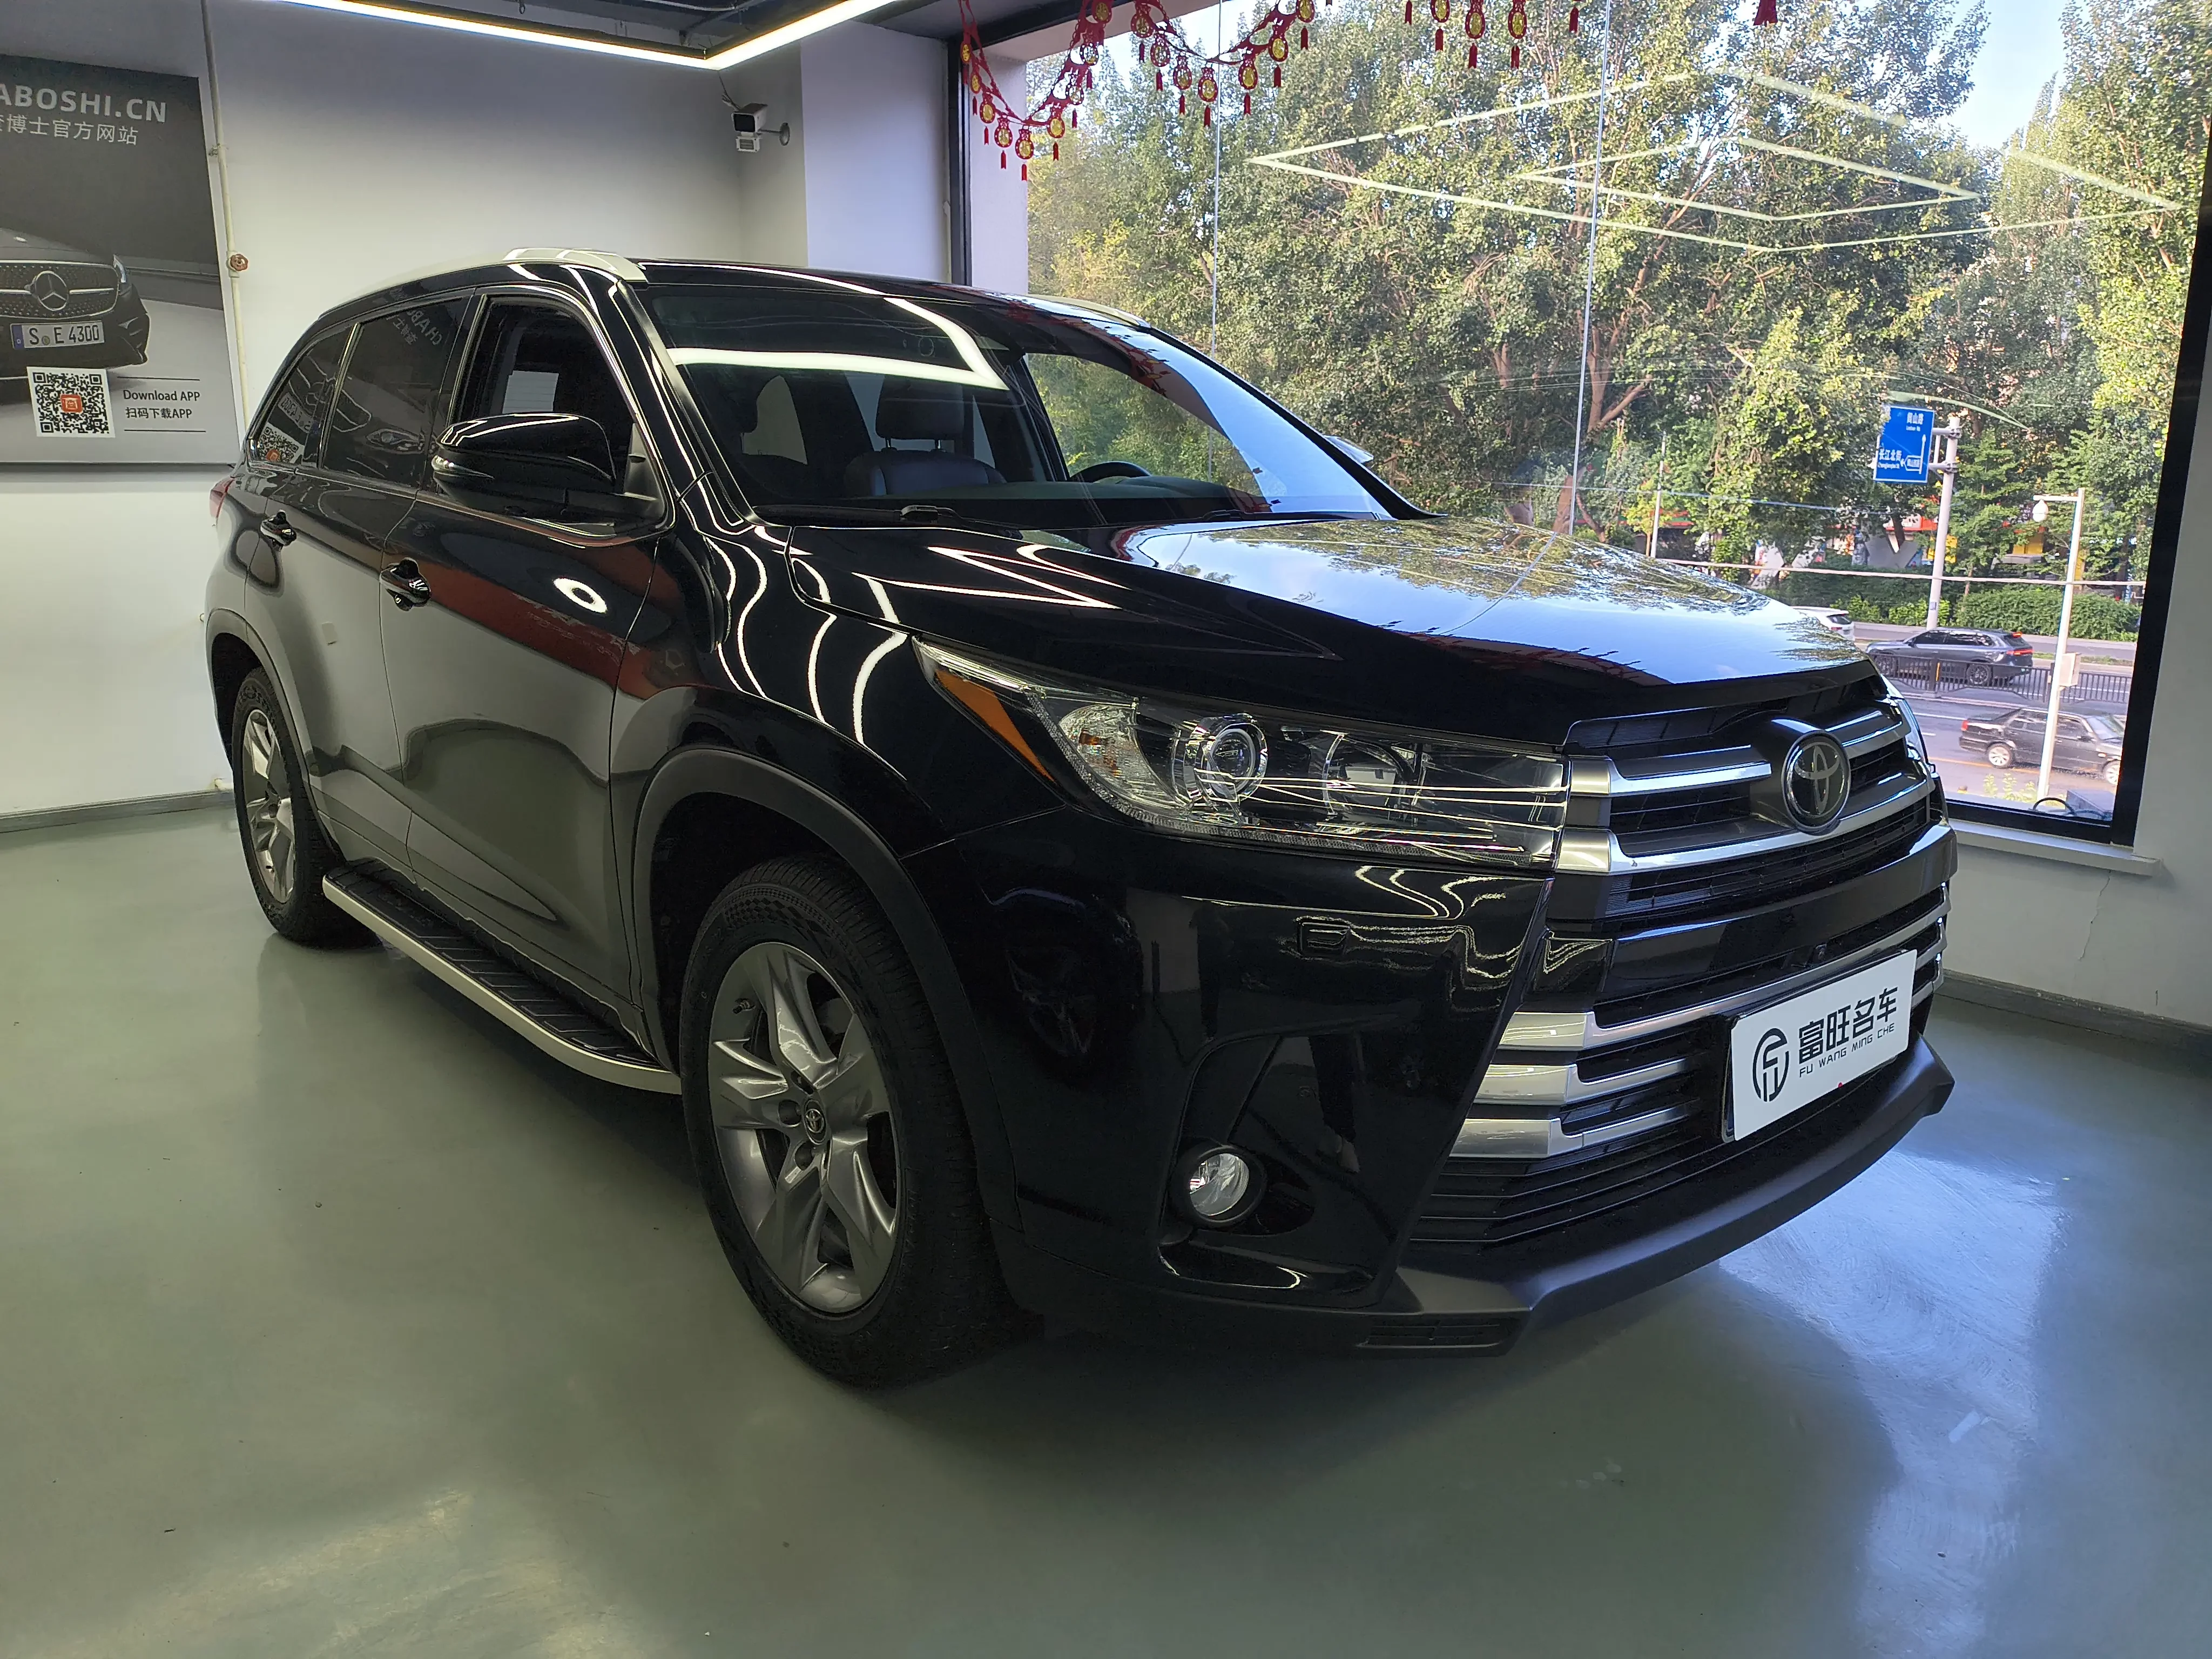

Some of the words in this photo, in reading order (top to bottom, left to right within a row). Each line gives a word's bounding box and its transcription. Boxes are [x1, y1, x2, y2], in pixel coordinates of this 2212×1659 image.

[0, 113, 139, 146] 博士官方网站
[29, 327, 40, 345] S
[54, 327, 65, 344] E
[69, 325, 100, 343] 4300
[123, 389, 178, 401] Download
[180, 390, 200, 402] APP
[125, 406, 192, 420] 扫码下载APP
[1799, 986, 1898, 1064] 富旺名车
[1799, 1063, 1813, 1078] FU
[1818, 1047, 1847, 1068] WANG
[1851, 1034, 1873, 1053] MING
[1877, 1022, 1895, 1039] CHE
